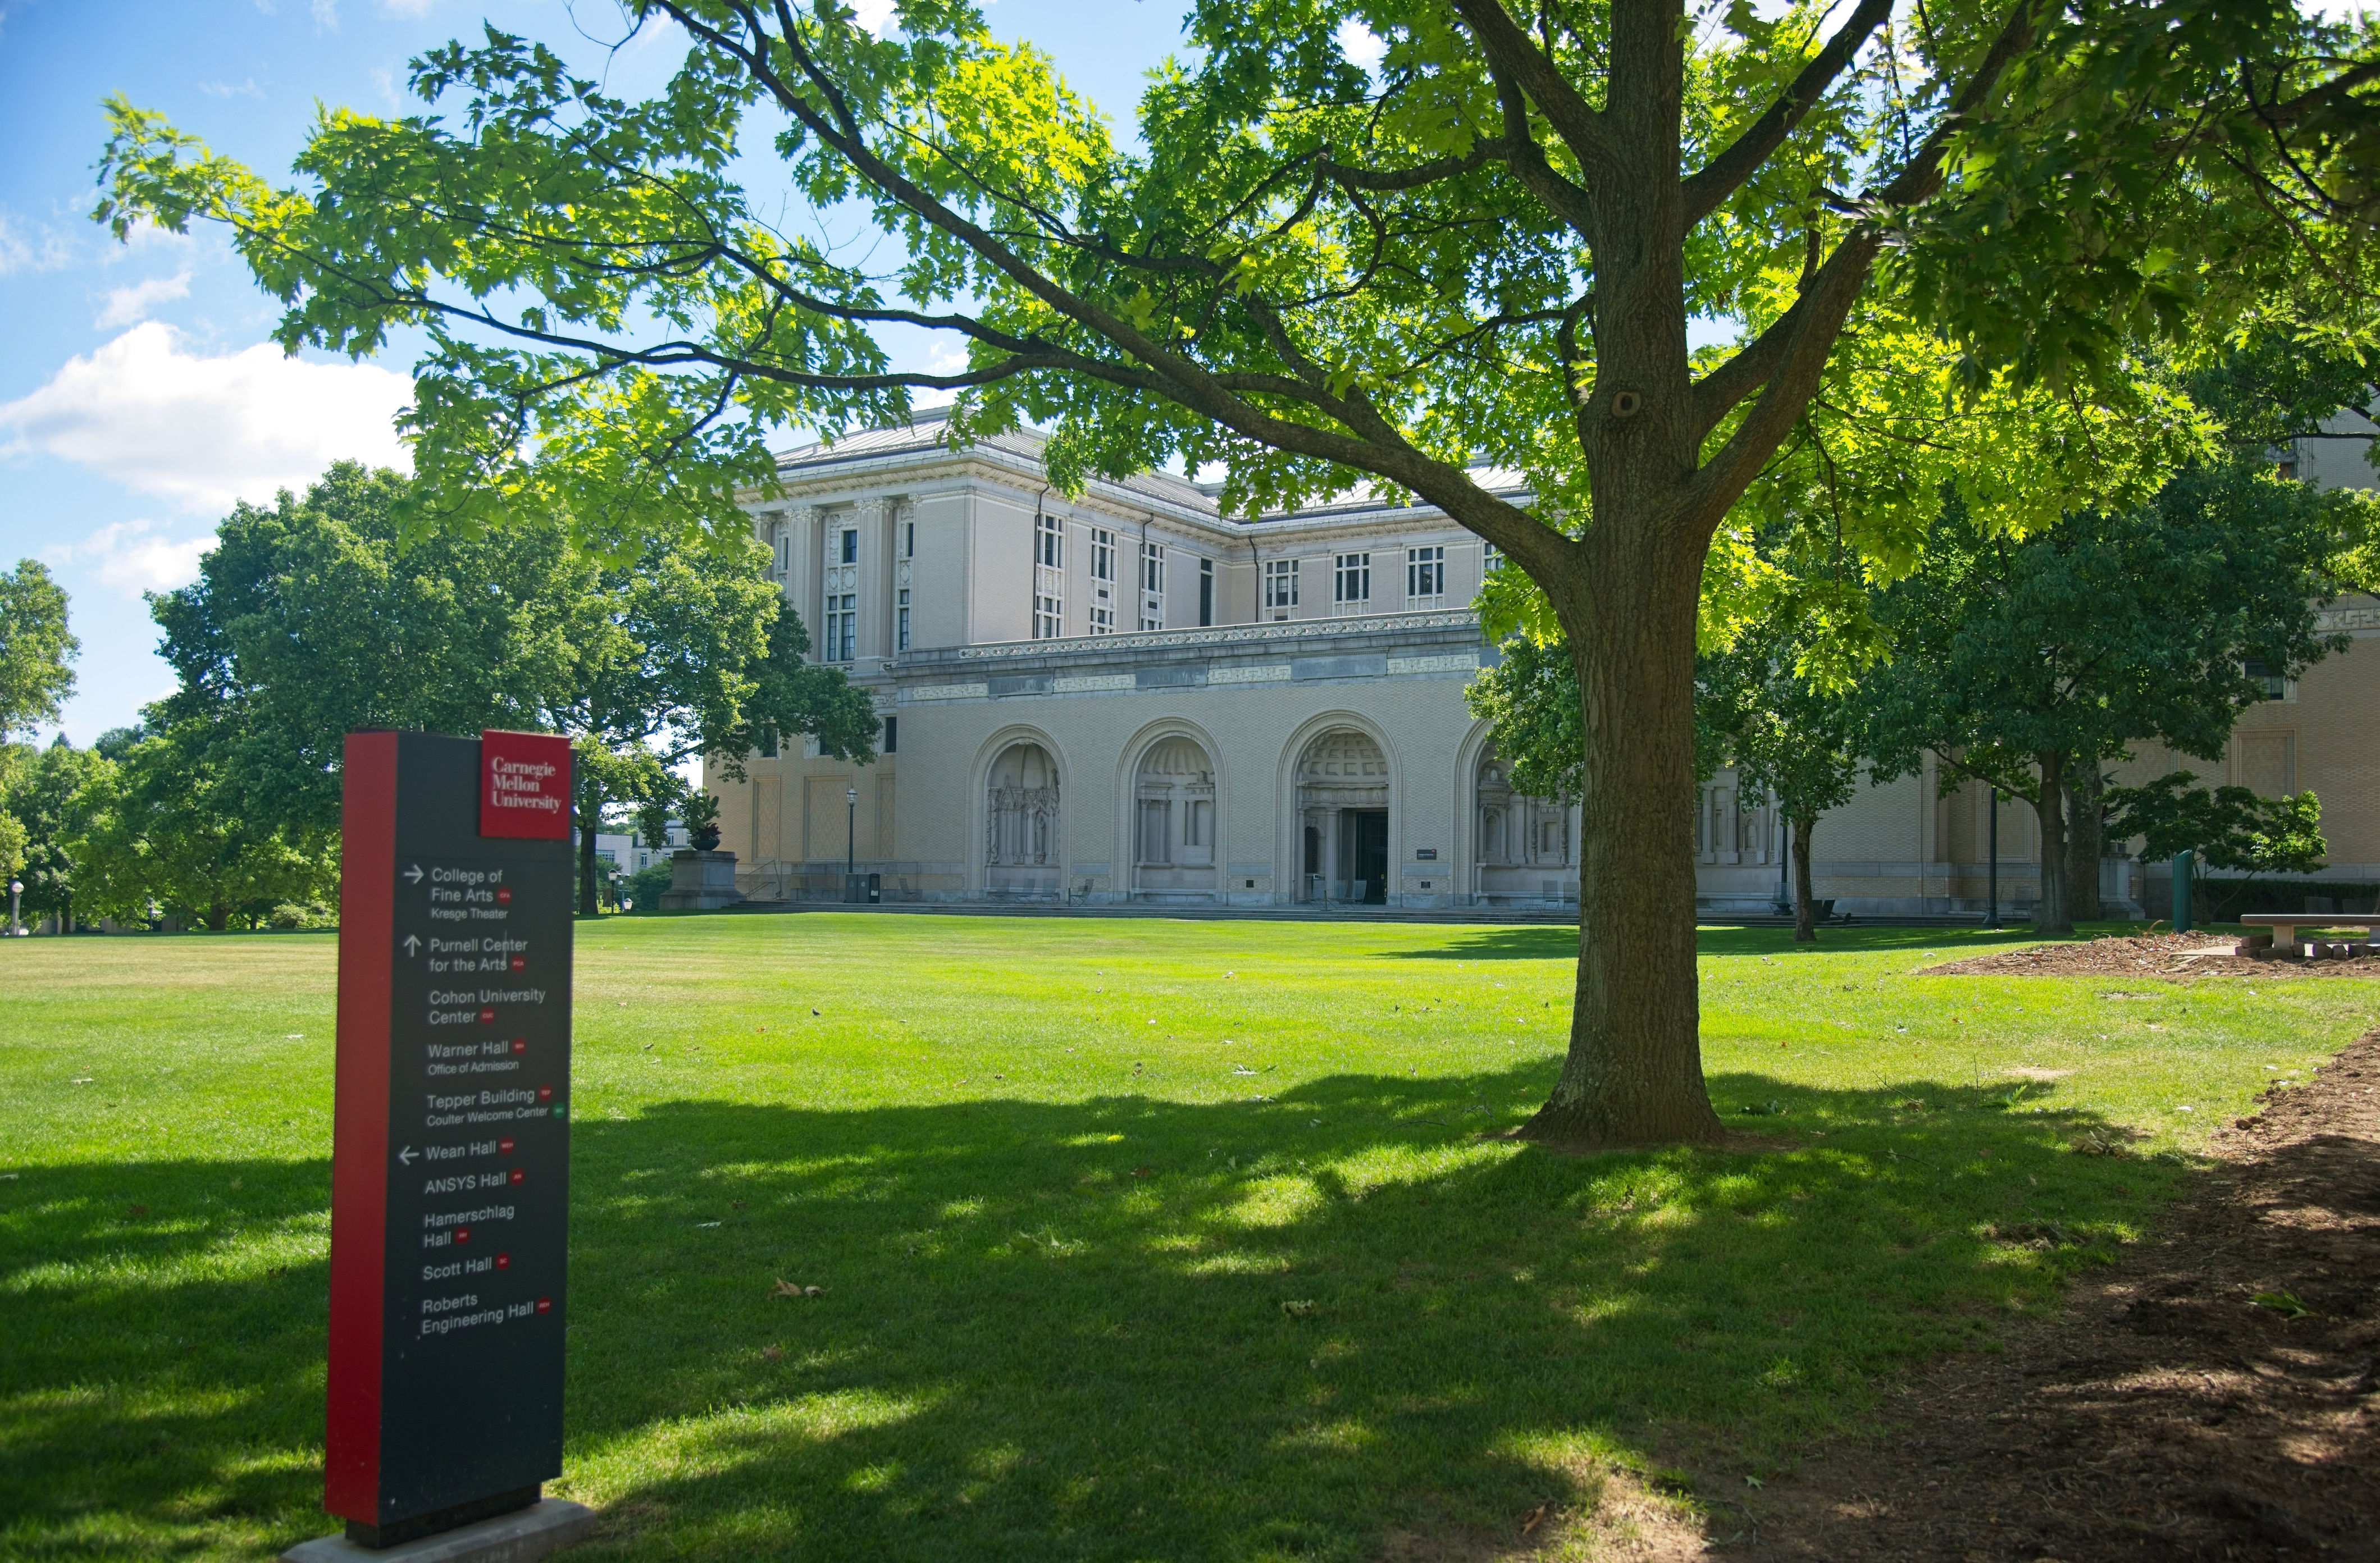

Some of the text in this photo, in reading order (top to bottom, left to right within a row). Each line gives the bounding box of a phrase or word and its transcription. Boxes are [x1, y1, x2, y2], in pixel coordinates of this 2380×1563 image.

[492, 757, 556, 780] Carnegie
[493, 773, 540, 793] Mellon
[492, 791, 562, 814] University
[432, 867, 503, 884] College of
[432, 888, 461, 901] Fine
[466, 889, 493, 902] Arts
[431, 908, 508, 921] Kresge Theater
[431, 938, 528, 952] Purnell Center
[430, 959, 449, 972] for
[454, 958, 475, 971] the
[480, 958, 508, 971] Arts
[430, 989, 545, 1004] Cohon University
[429, 1011, 476, 1024] Center
[428, 1044, 478, 1057] Warner
[483, 1041, 508, 1054] Hall
[428, 1061, 519, 1075] Office of Admission
[427, 1095, 476, 1110] Tepper
[481, 1089, 535, 1104] Building
[427, 1114, 465, 1126] Coulter
[468, 1111, 513, 1122] Welcome
[516, 1107, 548, 1118] Center
[427, 1146, 465, 1160] Wean
[471, 1141, 496, 1155] Hall
[425, 1175, 476, 1194] ANSYS
[481, 1172, 506, 1187] Hall
[425, 1205, 514, 1227] Hamerschlag
[424, 1231, 451, 1247] Hall
[423, 1263, 461, 1280] Scott
[466, 1257, 491, 1273] Hall
[423, 1294, 478, 1314] Roberts
[422, 1309, 504, 1335] Engineering
[509, 1301, 533, 1317] Hall
